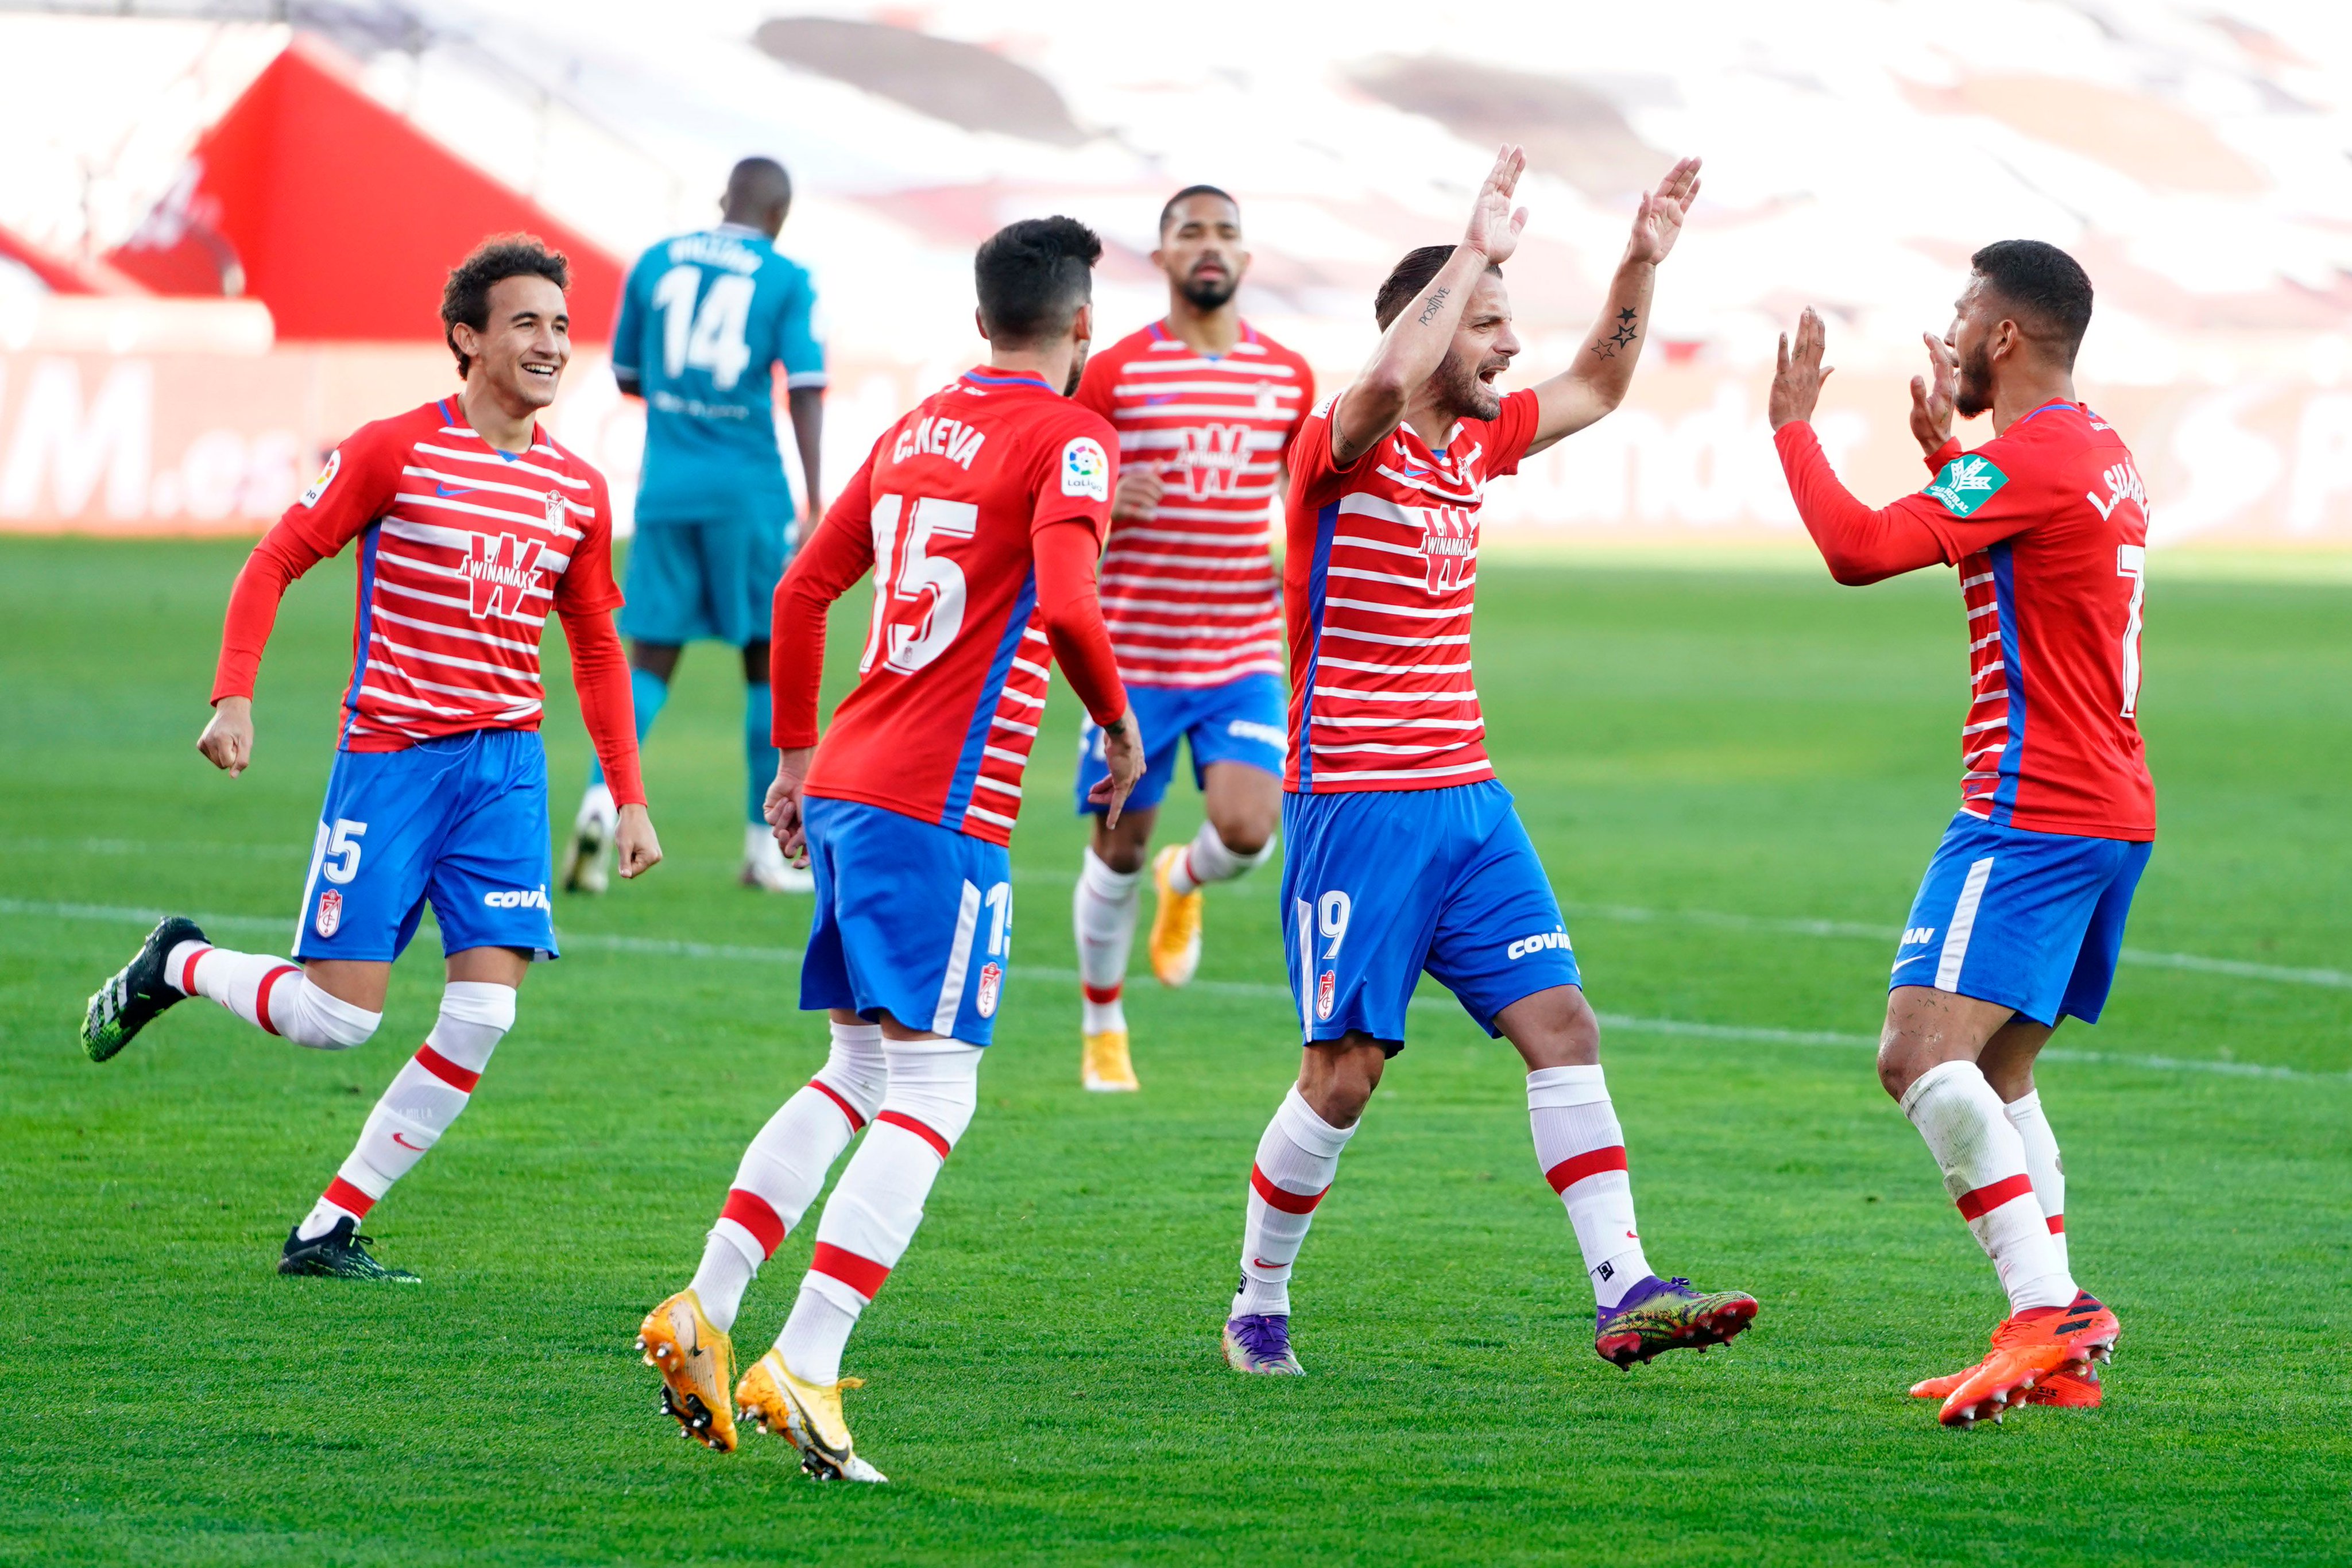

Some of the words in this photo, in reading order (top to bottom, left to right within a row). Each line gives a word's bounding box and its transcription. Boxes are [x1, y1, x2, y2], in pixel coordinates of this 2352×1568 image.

[651, 264, 756, 391] 14
[1418, 287, 1450, 327] POSITIVE
[0, 353, 301, 521] M.es
[893, 416, 985, 470] C.NEVA
[470, 559, 530, 589] WINAMAX
[1428, 536, 1469, 556] WINAMAX
[859, 493, 978, 675] 15
[2117, 544, 2145, 718] 7
[323, 818, 368, 885] 5
[1318, 890, 1351, 960] 9
